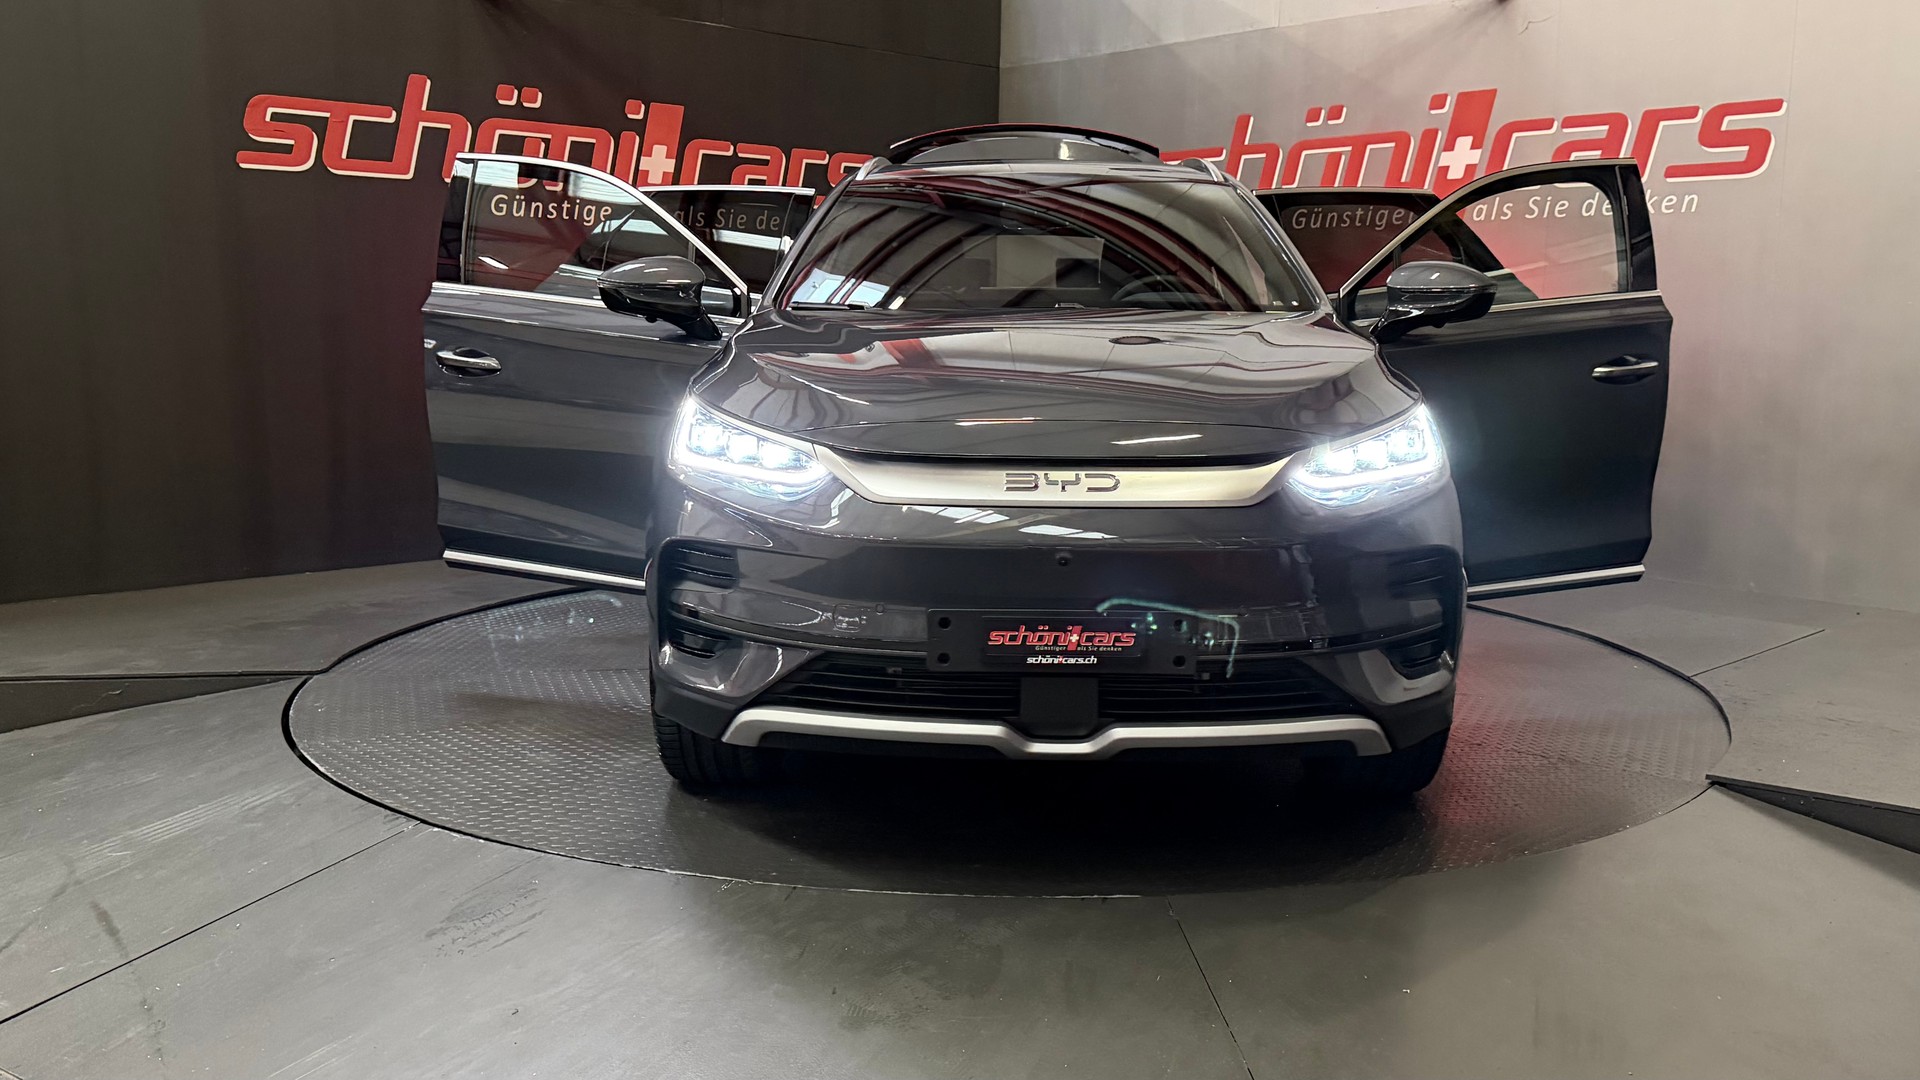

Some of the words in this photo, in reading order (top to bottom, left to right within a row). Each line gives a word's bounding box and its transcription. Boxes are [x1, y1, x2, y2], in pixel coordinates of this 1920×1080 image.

[491, 194, 612, 226] Günstige
[714, 207, 747, 229] Sie
[1472, 196, 1513, 222] als
[1525, 194, 1576, 219] Sie
[1581, 188, 1699, 218] deken
[1004, 472, 1121, 493] BYD
